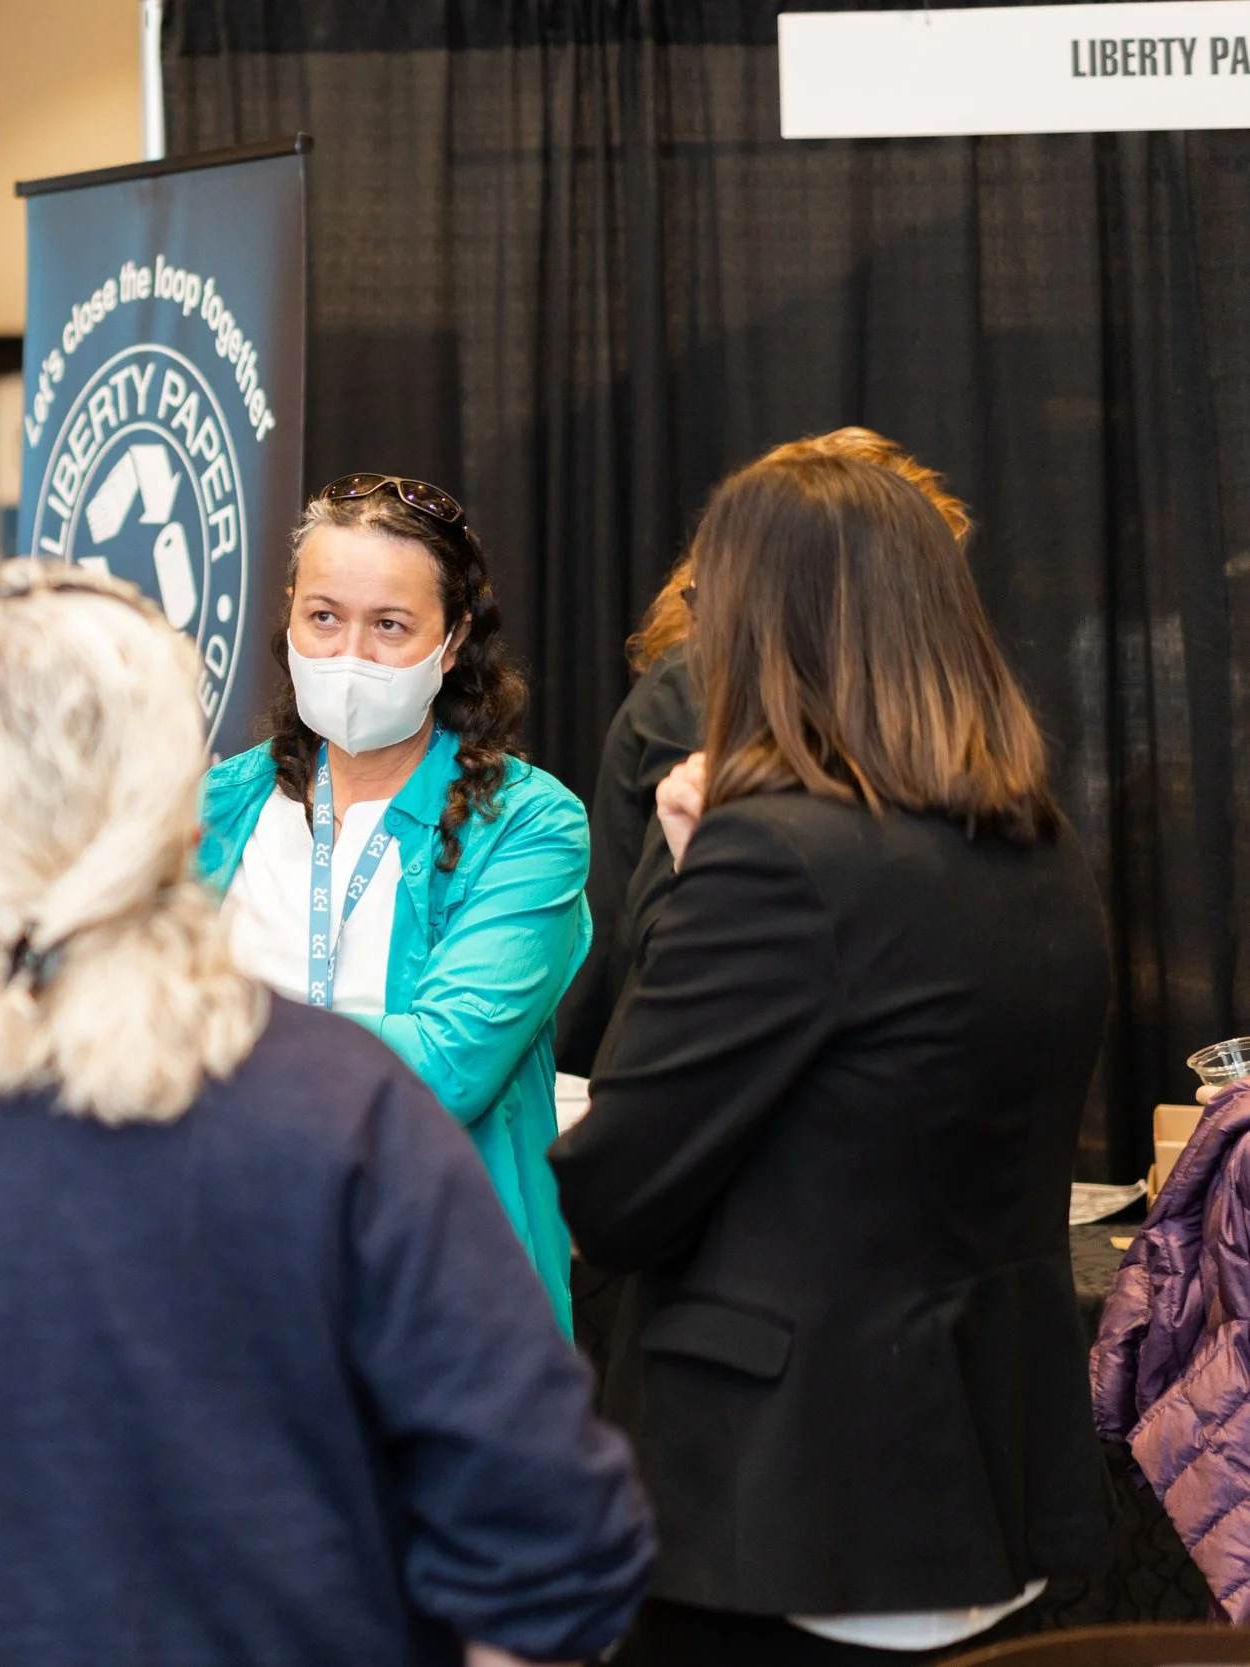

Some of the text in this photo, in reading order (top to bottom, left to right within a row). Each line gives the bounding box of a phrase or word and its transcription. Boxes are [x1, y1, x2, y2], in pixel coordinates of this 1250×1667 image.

[1070, 37, 1197, 77] LIBERTY
[24, 253, 276, 448] Let's close the loop together
[40, 362, 237, 564] LIBERTY PAPER
